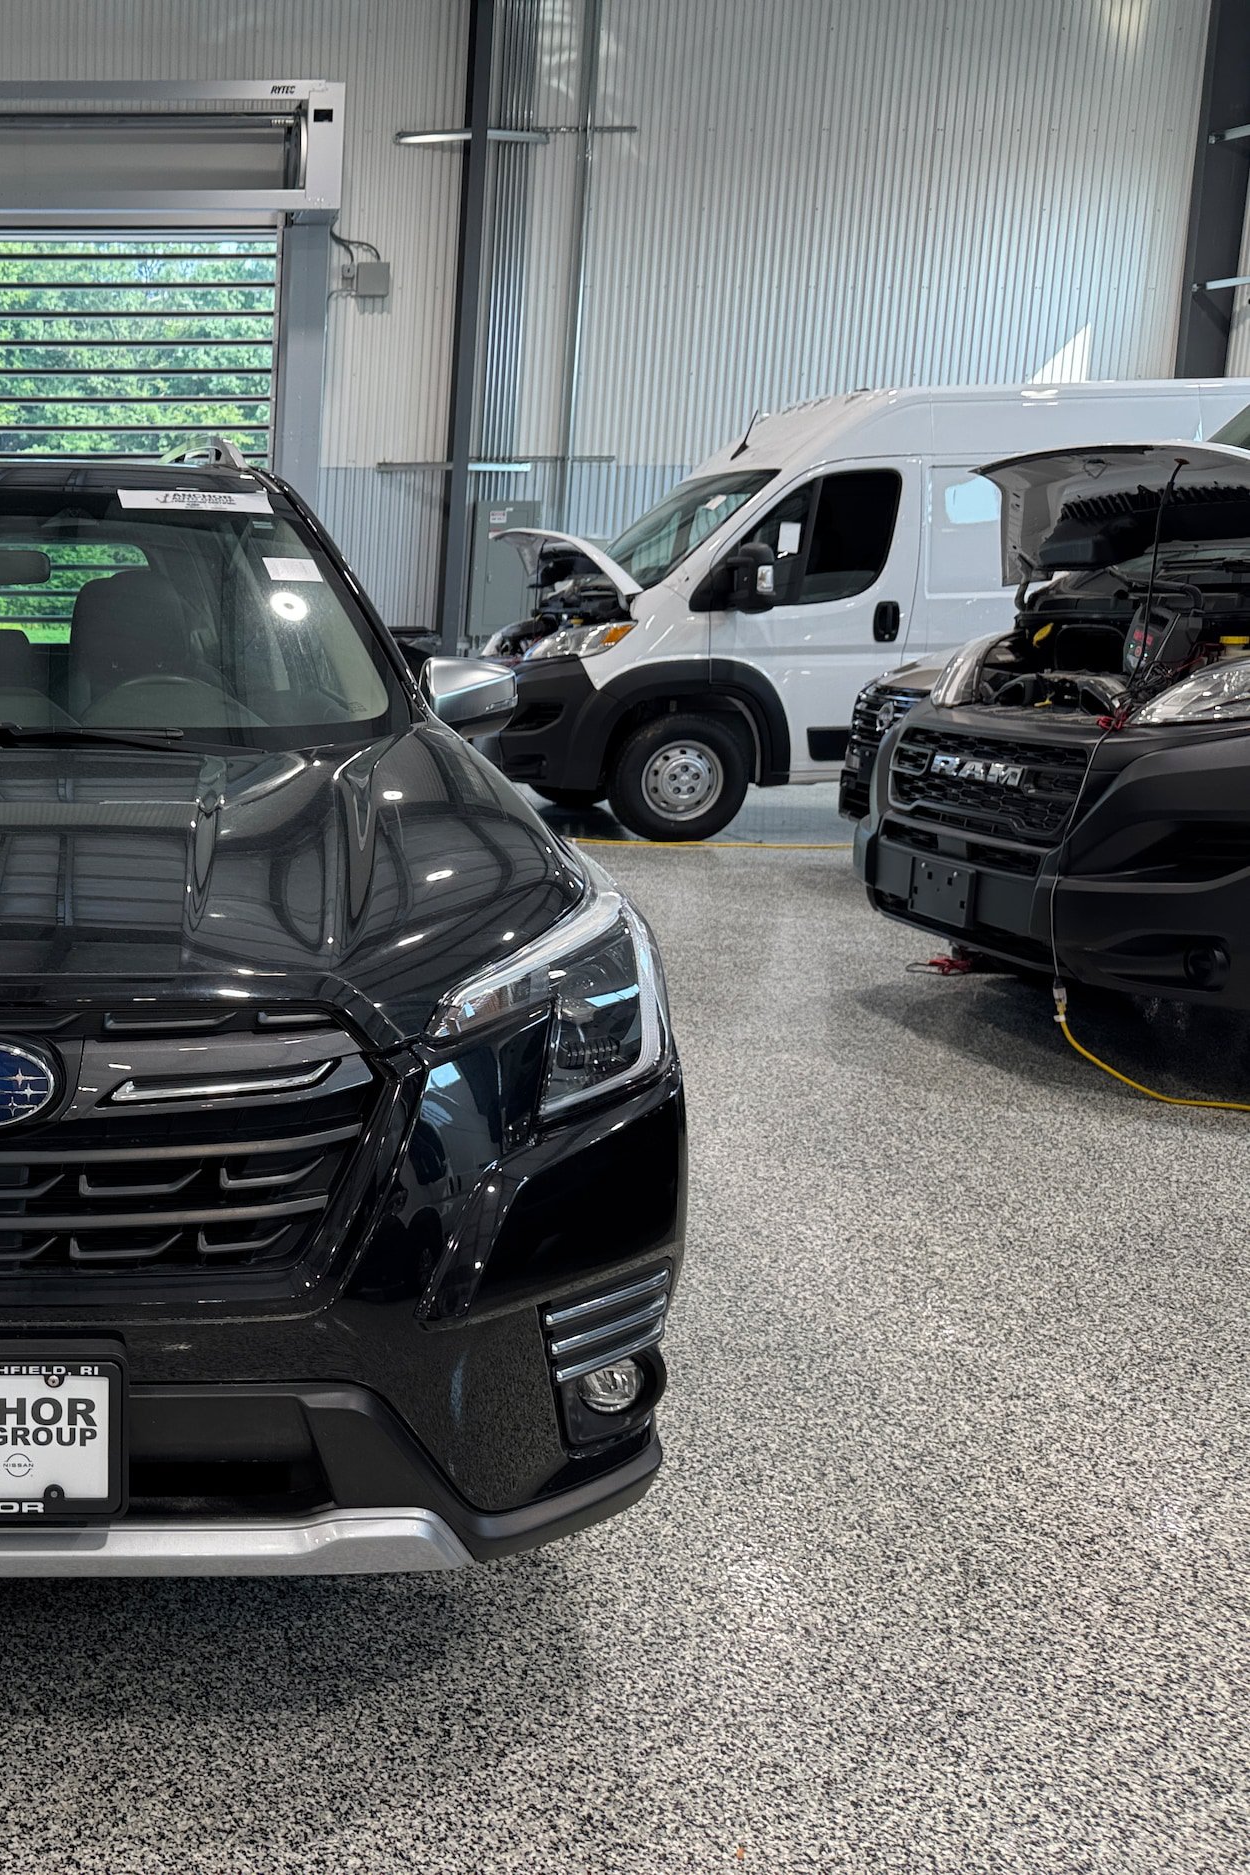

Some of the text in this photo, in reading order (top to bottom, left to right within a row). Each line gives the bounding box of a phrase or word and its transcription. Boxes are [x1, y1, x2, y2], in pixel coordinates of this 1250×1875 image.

[270, 85, 296, 95] RYTEC
[931, 755, 1025, 787] RAM
[79, 1365, 100, 1376] RI
